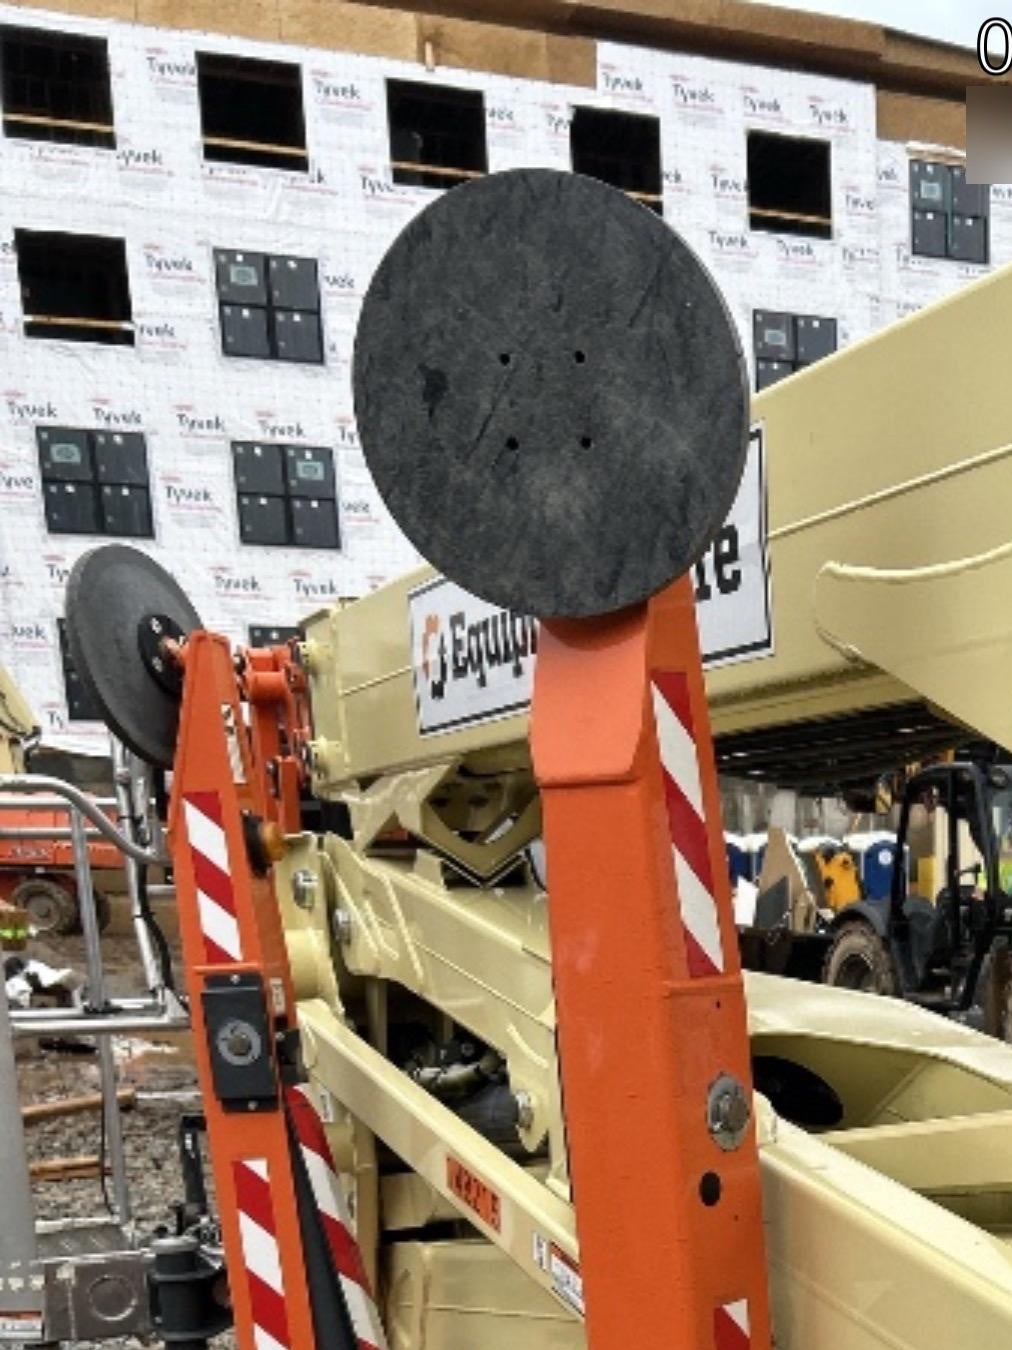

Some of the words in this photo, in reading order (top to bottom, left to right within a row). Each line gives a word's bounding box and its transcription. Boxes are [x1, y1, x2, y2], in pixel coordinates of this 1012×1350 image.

[8, 401, 58, 418] Tyvek
[93, 407, 143, 425] Tyvek
[177, 413, 226, 432] Tyvek
[259, 420, 306, 437] Tyvek
[166, 485, 213, 502] Tyvek
[293, 578, 339, 597] Tyvek
